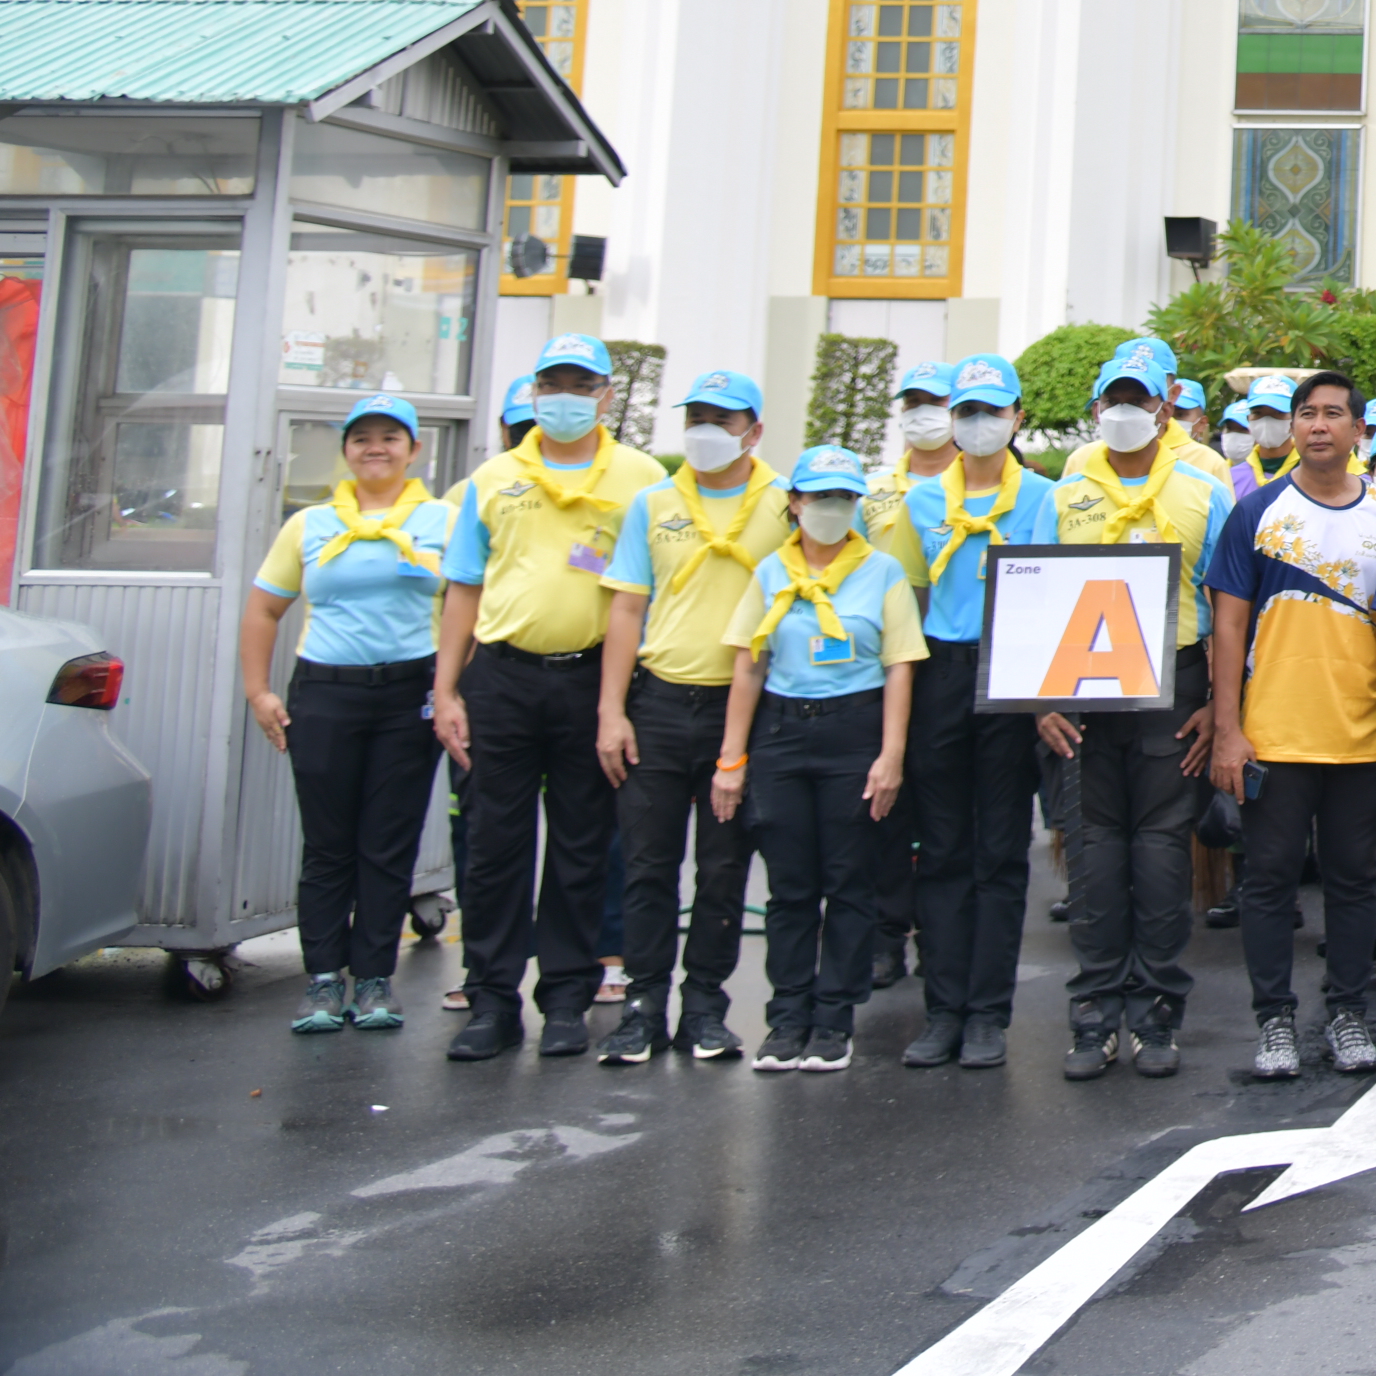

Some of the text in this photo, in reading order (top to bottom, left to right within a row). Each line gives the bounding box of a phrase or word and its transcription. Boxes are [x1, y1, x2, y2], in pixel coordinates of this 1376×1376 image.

[1067, 512, 1107, 531] 3A-308
[1006, 563, 1041, 575] Zone
[1037, 579, 1161, 697] A
